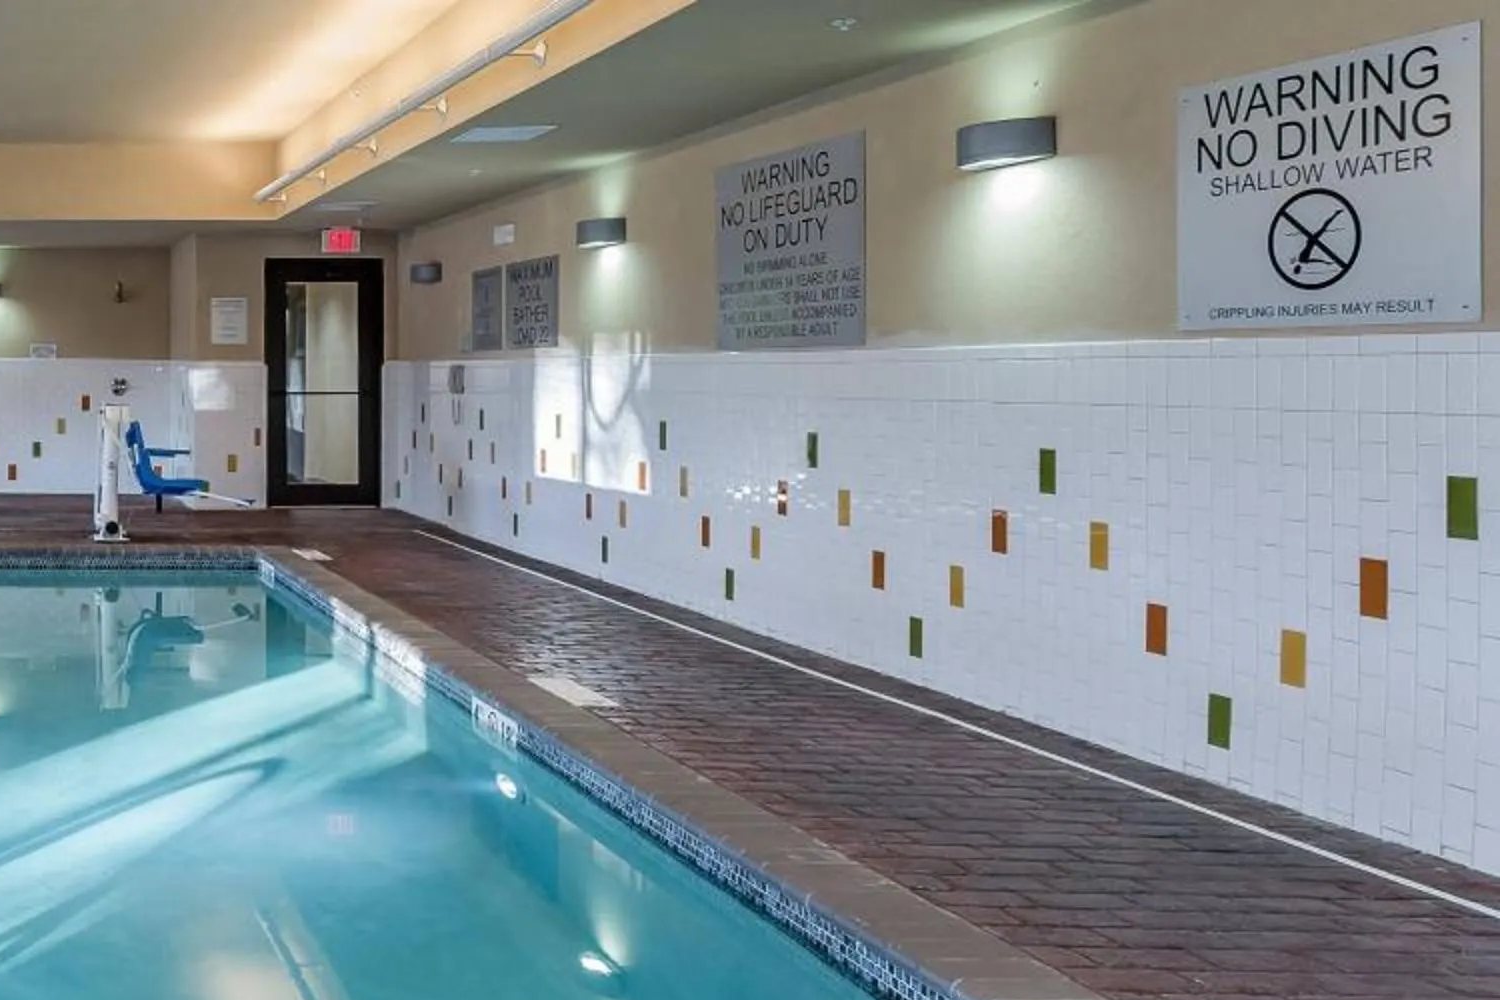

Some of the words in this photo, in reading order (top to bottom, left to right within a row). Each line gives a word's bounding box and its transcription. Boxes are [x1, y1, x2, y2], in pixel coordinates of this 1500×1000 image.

[1204, 45, 1440, 129] WARNING
[1197, 128, 1258, 174] NO
[1277, 93, 1452, 161] DIVING
[741, 151, 831, 195] WARNING
[1210, 162, 1325, 198] SHALLOW
[1336, 145, 1433, 180] WATER
[721, 201, 745, 229] NO
[750, 177, 858, 223] LIFEGUARD
[743, 228, 768, 253] ON
[775, 215, 829, 249] DUTY
[1209, 305, 1275, 321] CRIPPLING
[1278, 302, 1338, 317] INJURIES
[1341, 301, 1370, 316] MAY
[1375, 298, 1435, 314] RESULT
